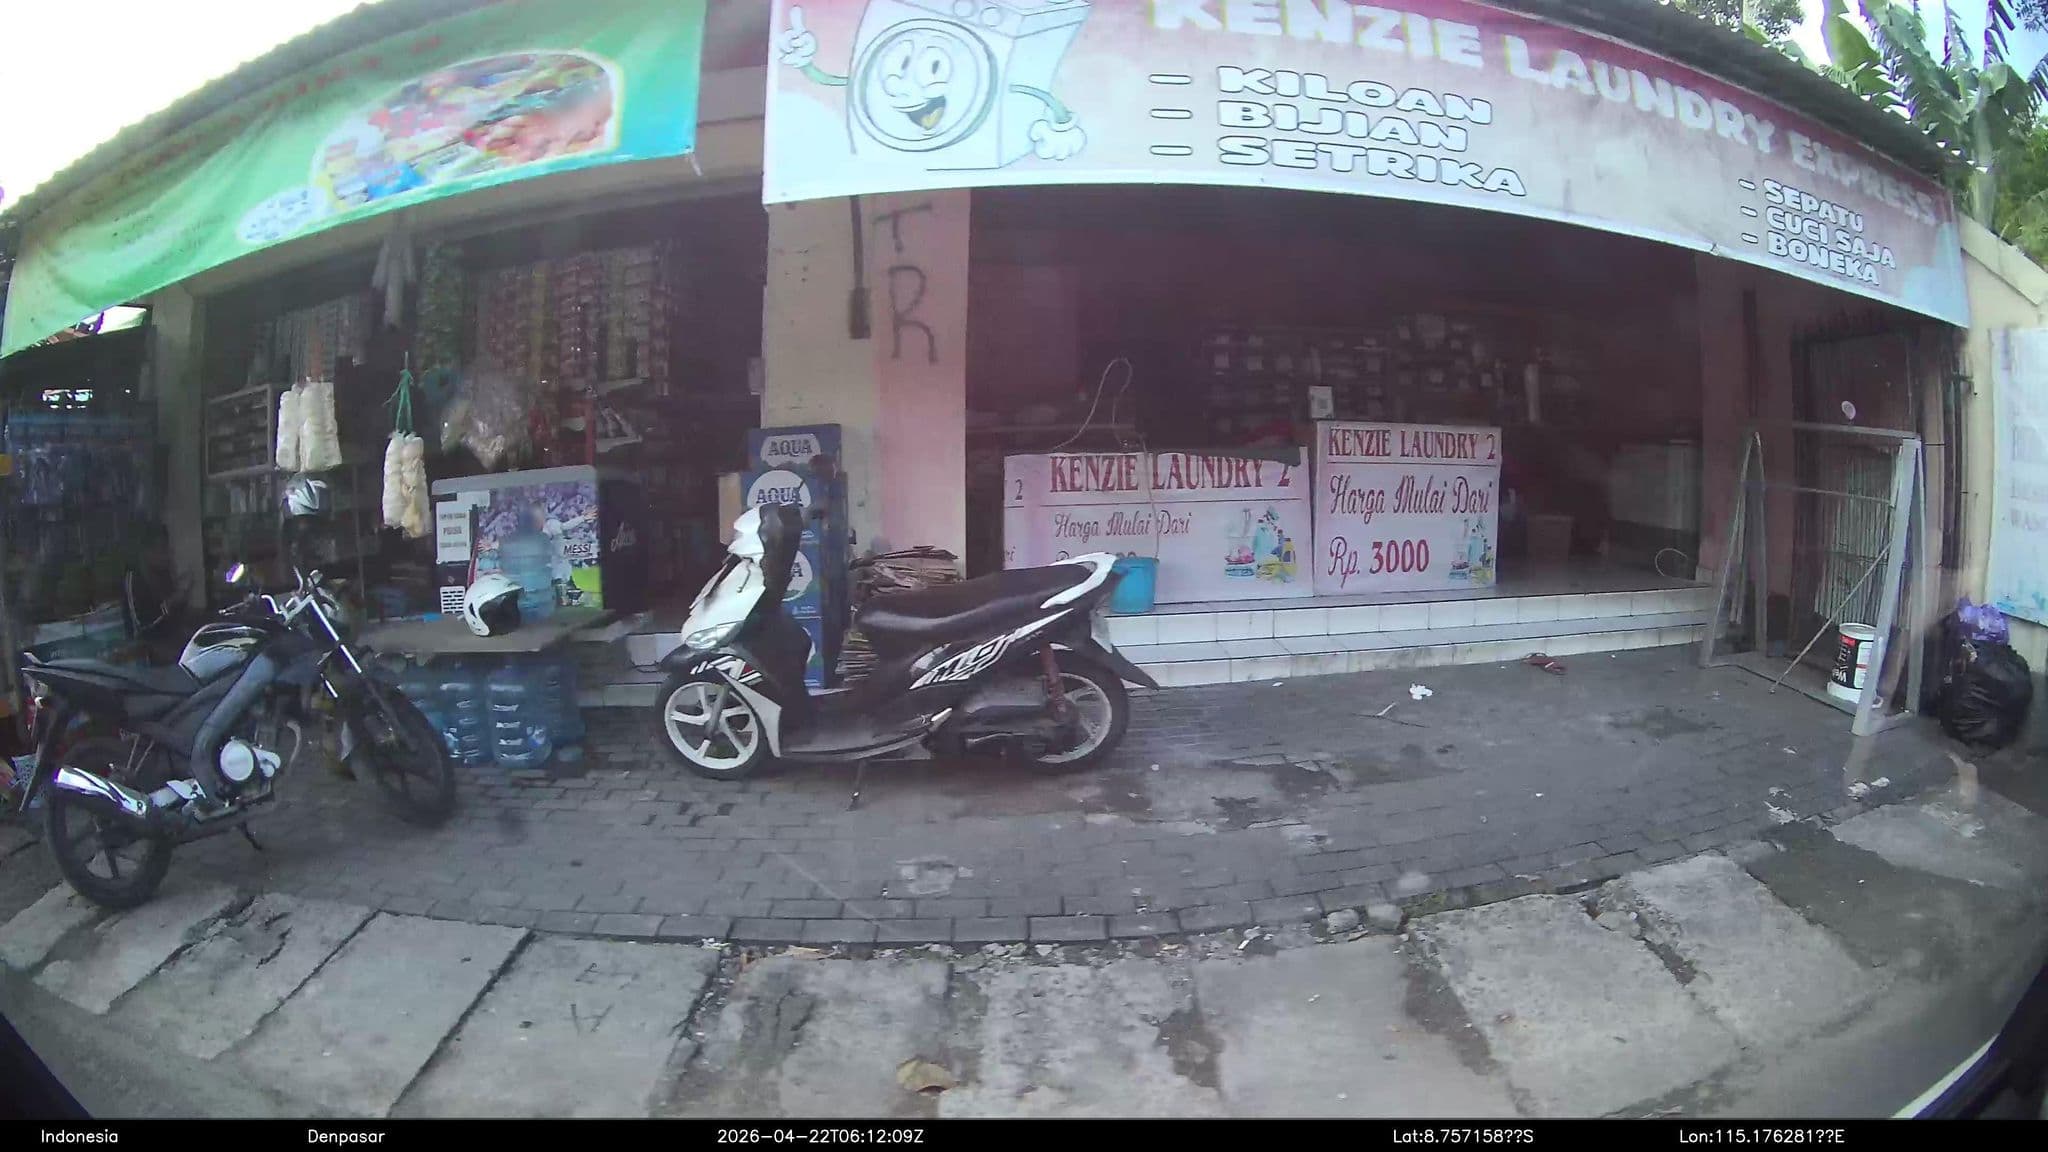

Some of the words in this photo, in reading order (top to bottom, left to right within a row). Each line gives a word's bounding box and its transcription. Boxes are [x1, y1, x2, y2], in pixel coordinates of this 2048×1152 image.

[1149, 0, 1484, 69] KENZIE
[1504, 34, 1775, 153] LAUNDRY
[1788, 129, 1937, 225] EXPRESS
[1217, 65, 1492, 125] KILOAN
[1217, 100, 1468, 152] BIJIAN
[1217, 135, 1527, 197] SETRIKA
[1763, 178, 1864, 232] SEPATU
[1766, 206, 1828, 245] CUCI
[1834, 229, 1896, 269] SAJA
[1767, 230, 1880, 286] BONEKA
[768, 439, 813, 457] AQUA
[1328, 427, 1392, 457] KENZIE
[1400, 430, 1479, 459] LAUNDRY
[1486, 434, 1496, 460] 2
[756, 487, 802, 504] AQUA
[1015, 479, 1024, 500] 2
[1050, 454, 1139, 492] KENZIE
[1151, 453, 1264, 490] LAUNDRY
[1329, 474, 1385, 525] Harga
[1393, 474, 1448, 514] Mulai
[1451, 475, 1493, 514] Dari
[564, 544, 592, 555] MESSI
[1054, 512, 1100, 544] Harga
[1105, 509, 1152, 537] Mulai
[1158, 509, 1193, 536] Dari
[1328, 536, 1361, 589] Rp.
[1369, 539, 1430, 574] 3000
